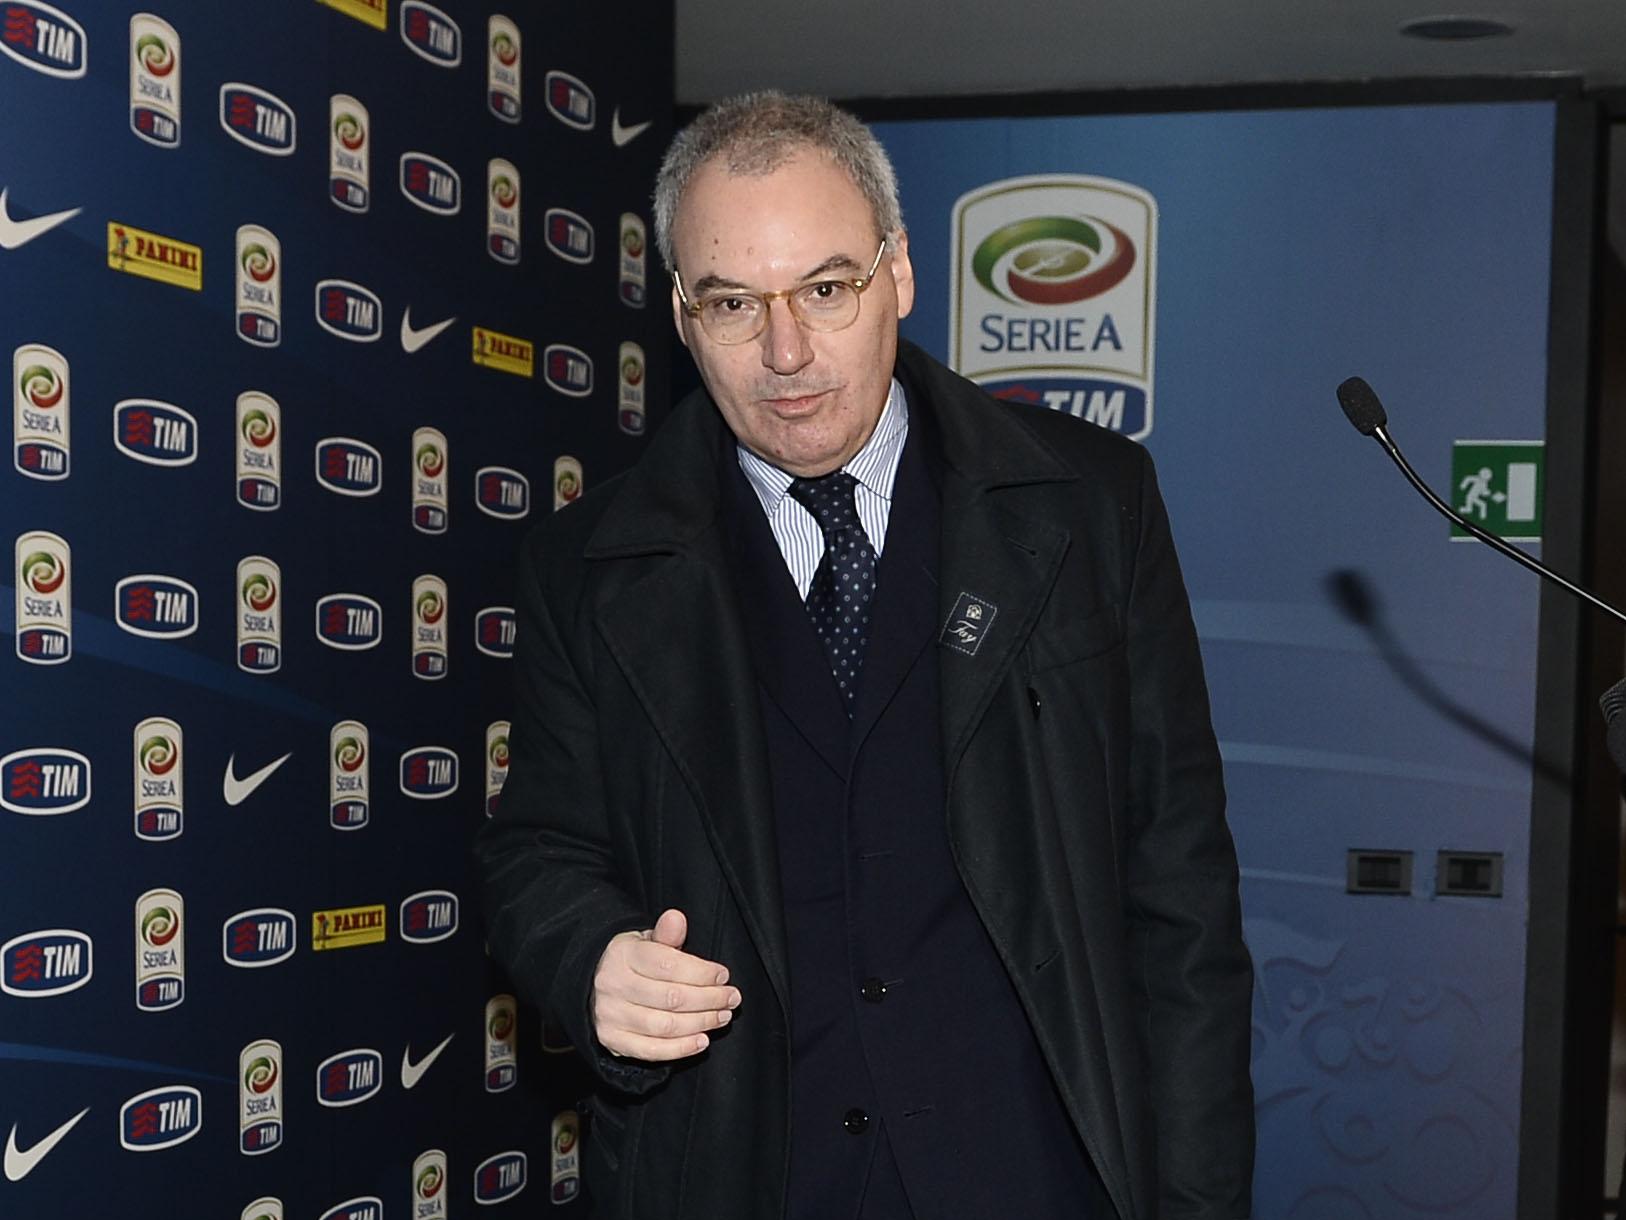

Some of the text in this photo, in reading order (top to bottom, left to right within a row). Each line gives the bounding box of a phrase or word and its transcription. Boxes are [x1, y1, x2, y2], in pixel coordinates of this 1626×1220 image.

[36, 18, 75, 63] TIM
[428, 21, 453, 56] TIM
[153, 115, 174, 140] TIM
[256, 103, 286, 143] TIM
[429, 171, 453, 203] TIM
[135, 236, 198, 272] PANINI
[347, 297, 373, 330] TIM
[257, 319, 275, 339] TIM
[979, 313, 1122, 352] SERIE A
[23, 409, 51, 432] SERIE
[154, 417, 187, 452] TIM
[40, 449, 63, 470] TIM
[347, 453, 373, 483] TIM
[257, 484, 275, 502] TIM
[501, 481, 523, 507] TIM
[25, 596, 52, 617] SERIE
[155, 591, 188, 624] TIM
[347, 609, 373, 636] TIM
[42, 634, 64, 655] TIM
[257, 647, 275, 665] TIM
[42, 764, 79, 797] TIM
[428, 759, 451, 785] TIM
[143, 779, 167, 797] SERIE
[157, 812, 177, 830] TIM
[348, 806, 364, 821] TIM
[333, 909, 383, 932] PANINI
[428, 902, 451, 928] TIM
[258, 921, 287, 952] TIM
[43, 944, 81, 979] TIM
[144, 951, 168, 968] SERIE
[159, 981, 179, 1001] TIM
[348, 1061, 374, 1090] TIM
[159, 1098, 191, 1133] TIM
[246, 1097, 268, 1116] SERIE
[260, 1125, 277, 1145] TIM
[499, 1163, 521, 1189] TIM
